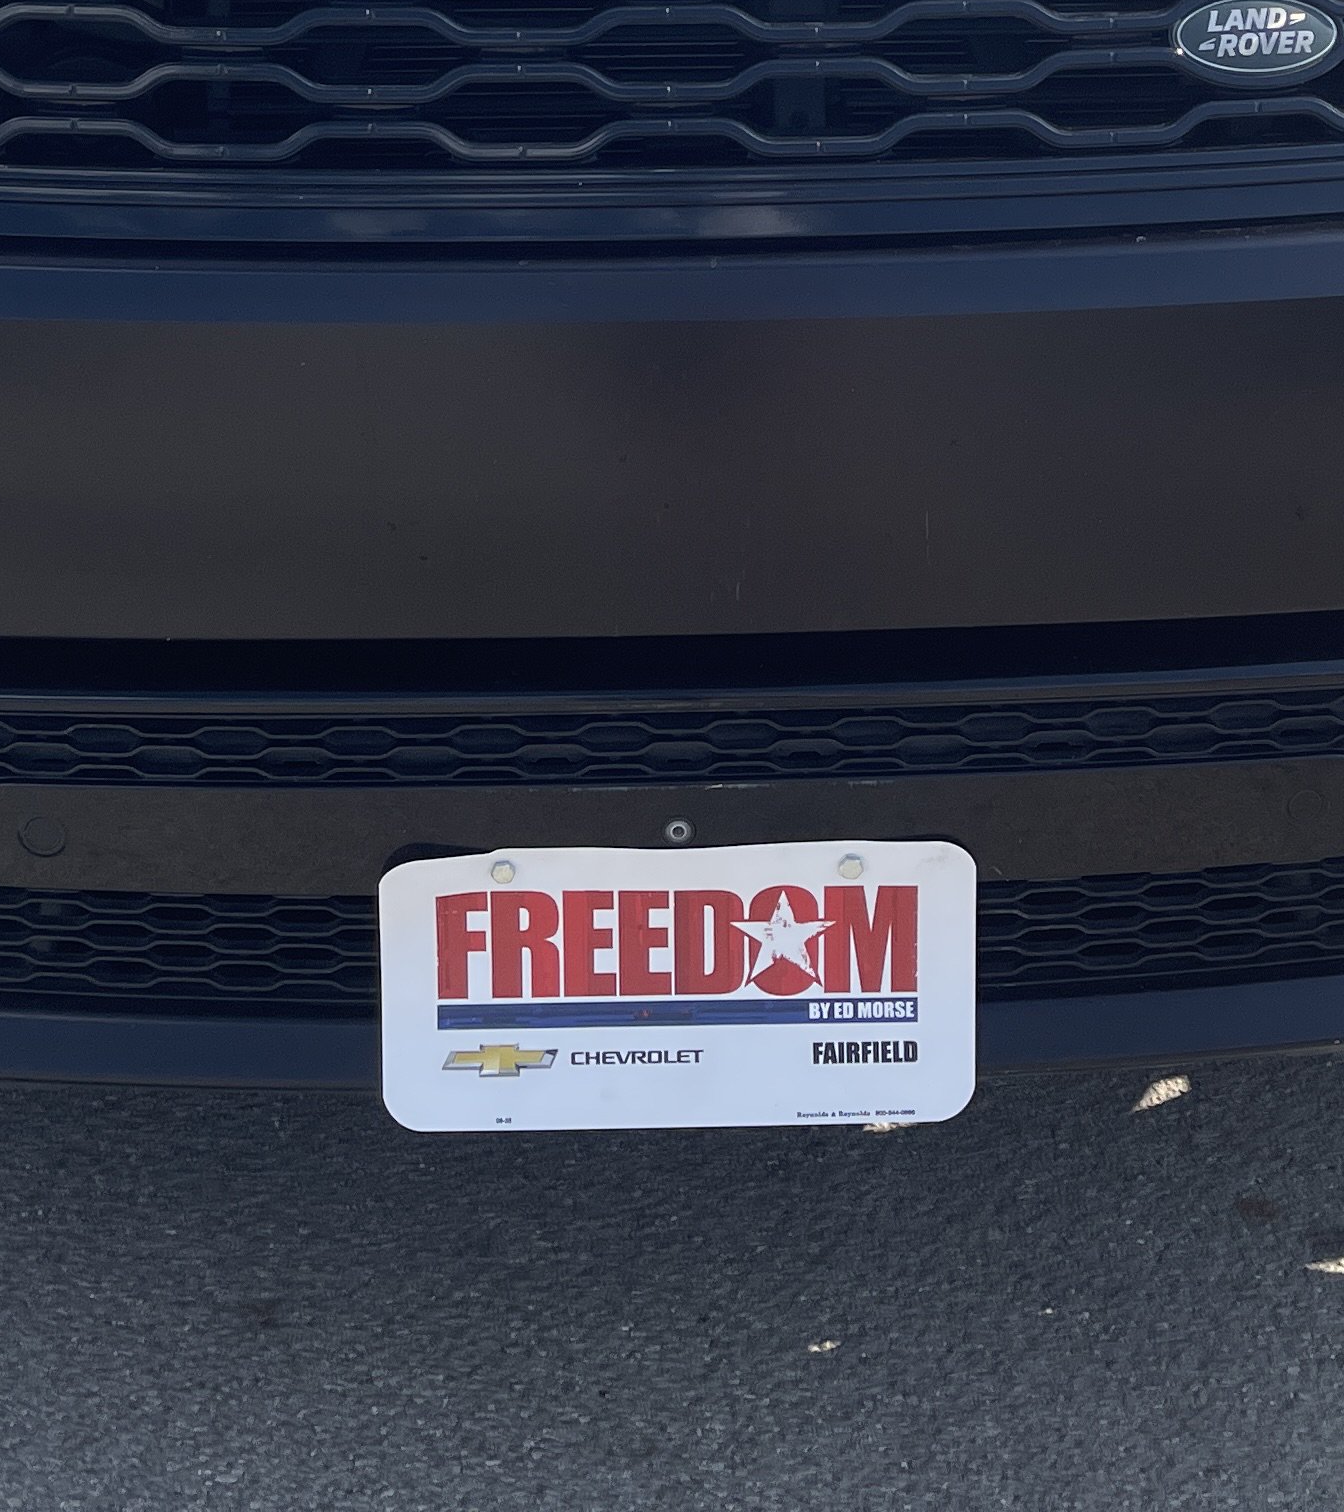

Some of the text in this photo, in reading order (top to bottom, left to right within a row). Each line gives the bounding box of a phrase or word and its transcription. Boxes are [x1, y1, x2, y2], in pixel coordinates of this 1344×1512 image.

[1207, 7, 1287, 33] LAND
[1217, 30, 1315, 58] ROVER
[435, 885, 918, 999] FREEDOM
[808, 1001, 915, 1019] BY ED MORSE
[570, 1048, 704, 1066] CHEVROLET
[812, 1040, 918, 1065] FAIRFIELD
